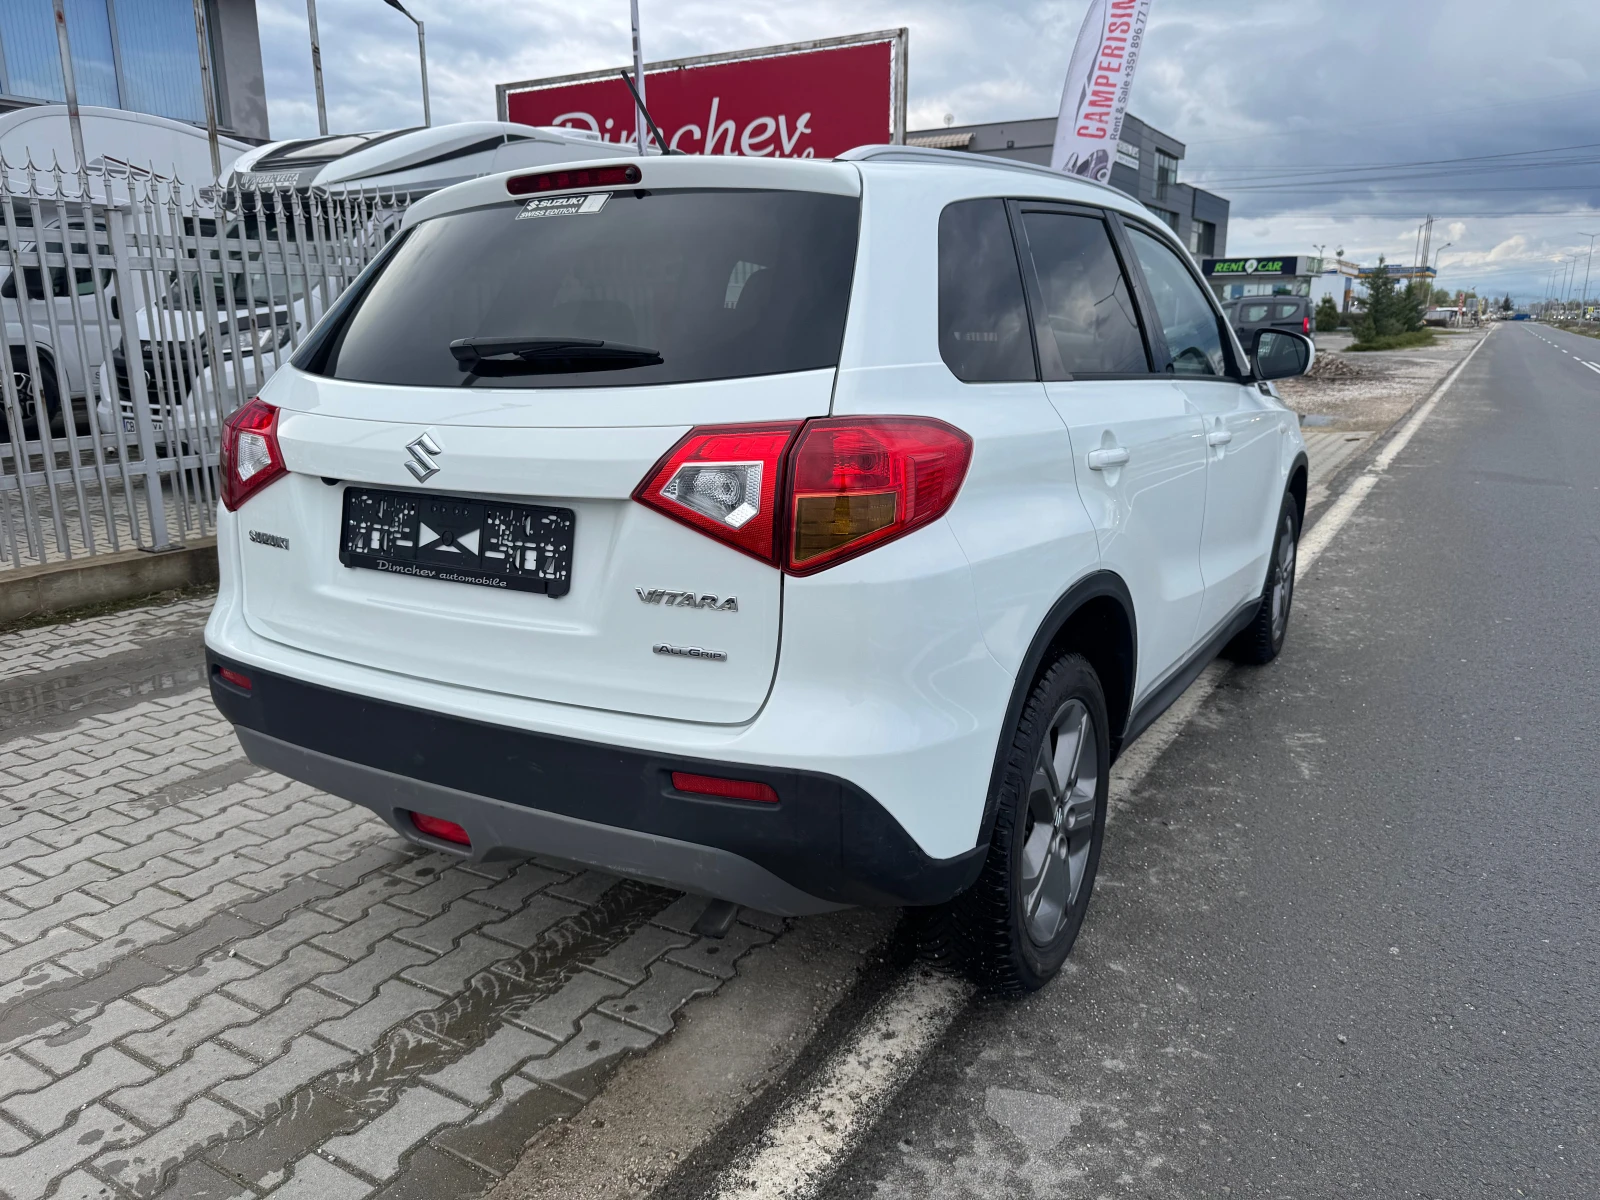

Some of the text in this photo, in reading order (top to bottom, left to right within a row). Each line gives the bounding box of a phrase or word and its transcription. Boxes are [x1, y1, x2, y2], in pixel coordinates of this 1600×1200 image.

[1135, 10, 1147, 25] 77
[1130, 27, 1143, 49] 896
[1125, 52, 1137, 79] +359
[1117, 81, 1131, 104] Sale
[1115, 106, 1125, 115] &
[1109, 116, 1122, 141] Rent
[519, 207, 578, 218] SWISS EDITION
[538, 197, 586, 208] SUZUKI
[1257, 261, 1283, 271] CAR
[248, 529, 290, 551] SUZUKI
[376, 559, 508, 588] Dimchev automobile
[635, 587, 739, 612] VITARA
